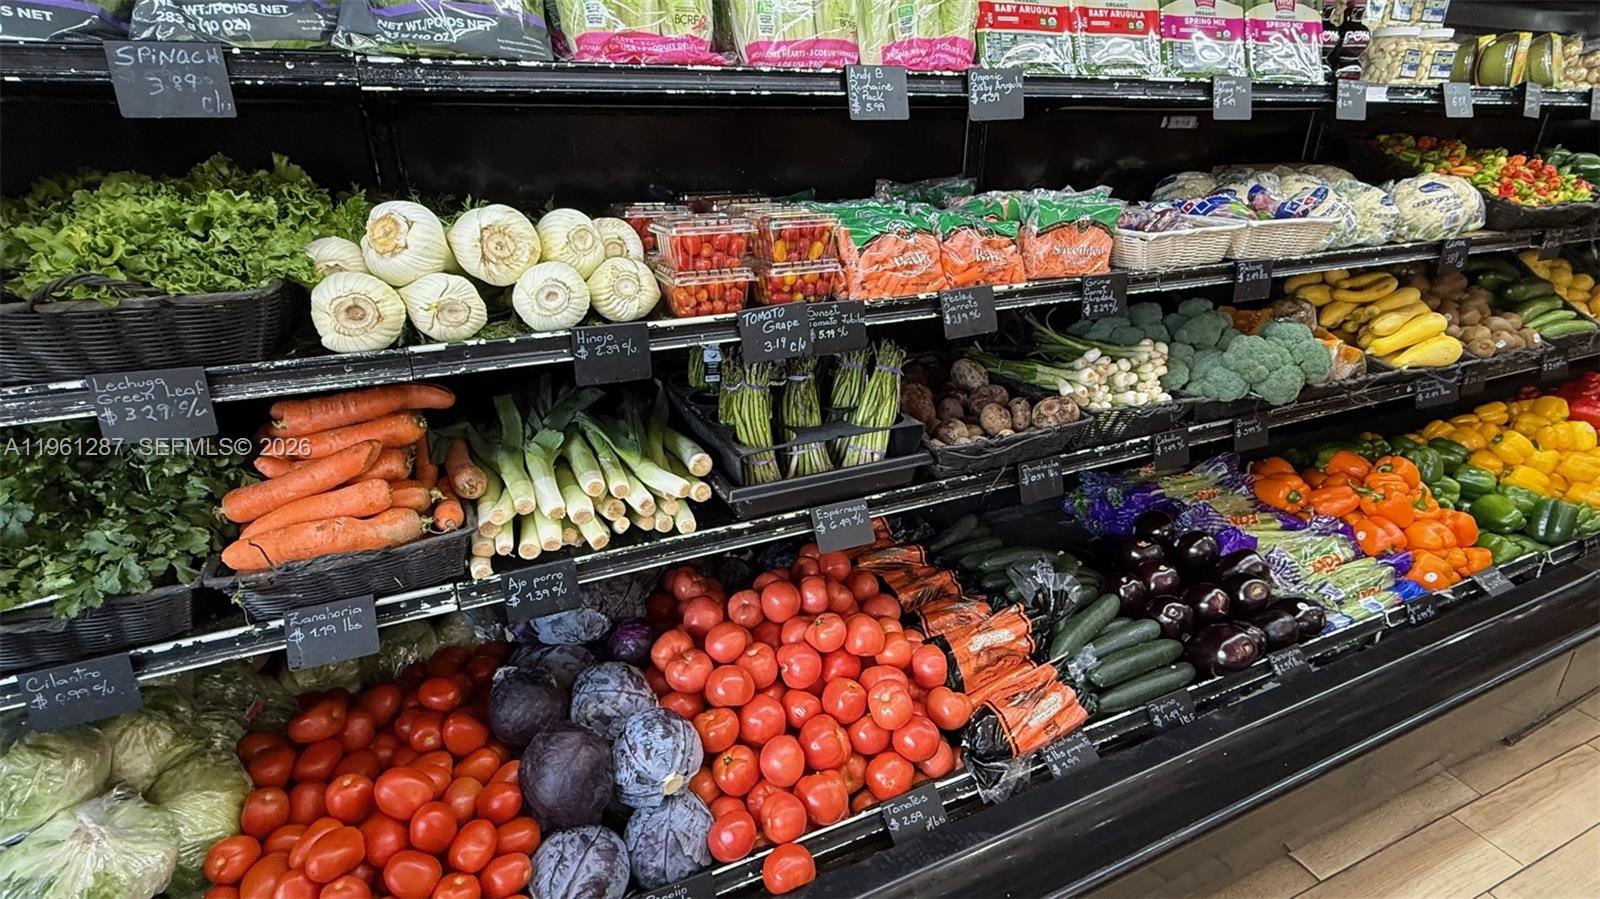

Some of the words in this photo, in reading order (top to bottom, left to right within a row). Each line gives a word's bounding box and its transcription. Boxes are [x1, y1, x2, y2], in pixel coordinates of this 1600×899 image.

[16, 7, 54, 21] NET
[260, 4, 289, 14] NET
[994, 4, 1017, 13] BABY
[1019, 5, 1058, 16] ARUGULA
[1088, 9, 1108, 18] BABY
[1110, 10, 1145, 19] ARUGULA
[376, 18, 403, 31] NET
[467, 18, 492, 32] NET
[1184, 17, 1212, 26] SPRING
[1266, 21, 1292, 29] SPRING
[849, 66, 871, 86] Andy
[874, 67, 884, 79] B
[862, 90, 885, 101] Pack
[942, 290, 974, 303] Peeled
[806, 303, 841, 318] Sunset
[943, 299, 979, 314] Carrots
[762, 318, 800, 334] Grape
[575, 329, 614, 348] Hinojo
[763, 336, 787, 353] 3.19
[574, 344, 590, 361] $
[594, 343, 620, 356] 2.39
[92, 375, 166, 394] Lechuga
[96, 391, 156, 405] Green
[164, 379, 205, 399] Leaf
[97, 406, 118, 427] $
[507, 576, 528, 597] Ajo
[532, 571, 564, 589] porro
[505, 594, 521, 608] $
[525, 588, 551, 602] 1.39
[287, 605, 363, 627] Zanahoria
[287, 626, 305, 646] $
[342, 616, 363, 633] lbs
[25, 666, 101, 693] Cilantro
[29, 692, 48, 711] $
[882, 794, 929, 815] Tomates
